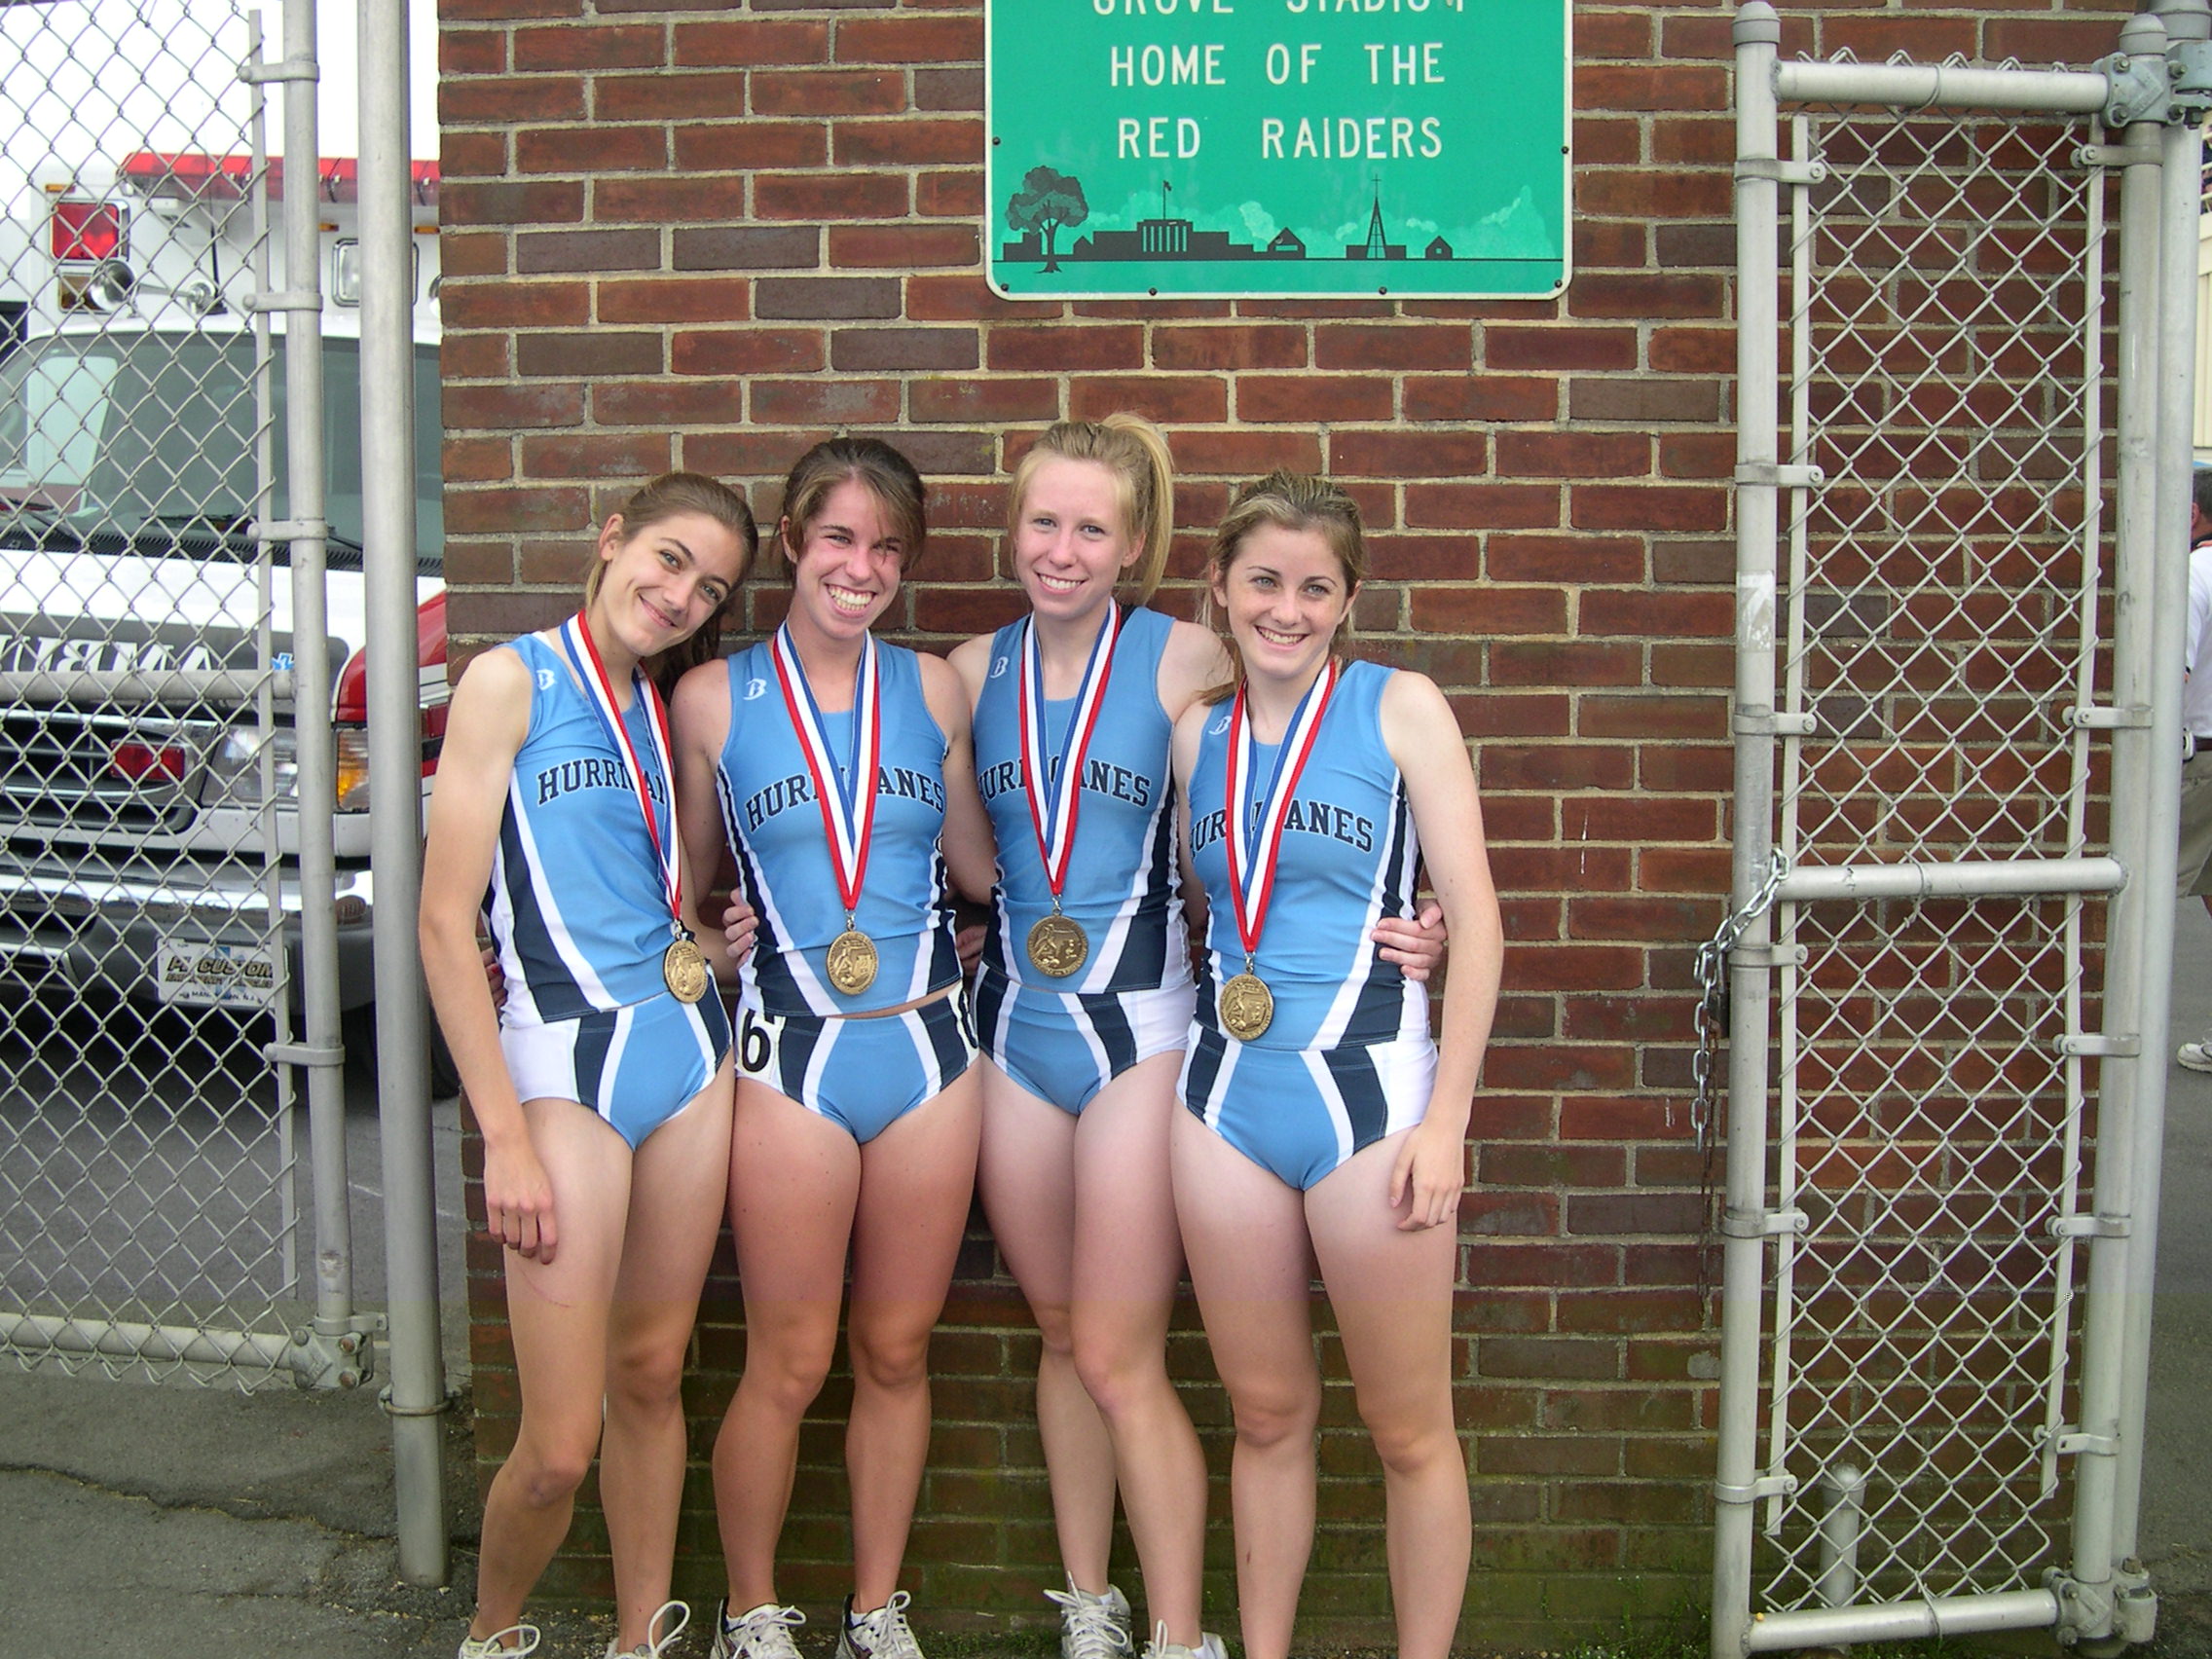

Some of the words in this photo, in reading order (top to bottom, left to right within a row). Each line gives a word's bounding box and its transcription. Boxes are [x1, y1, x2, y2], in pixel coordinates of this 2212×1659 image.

[1111, 44, 1226, 87] HOME
[1266, 43, 1322, 85] OF
[1364, 42, 1446, 86] THE
[1118, 117, 1201, 160] RED
[1262, 116, 1443, 160] RAIDERS
[741, 1008, 771, 1073] 6
